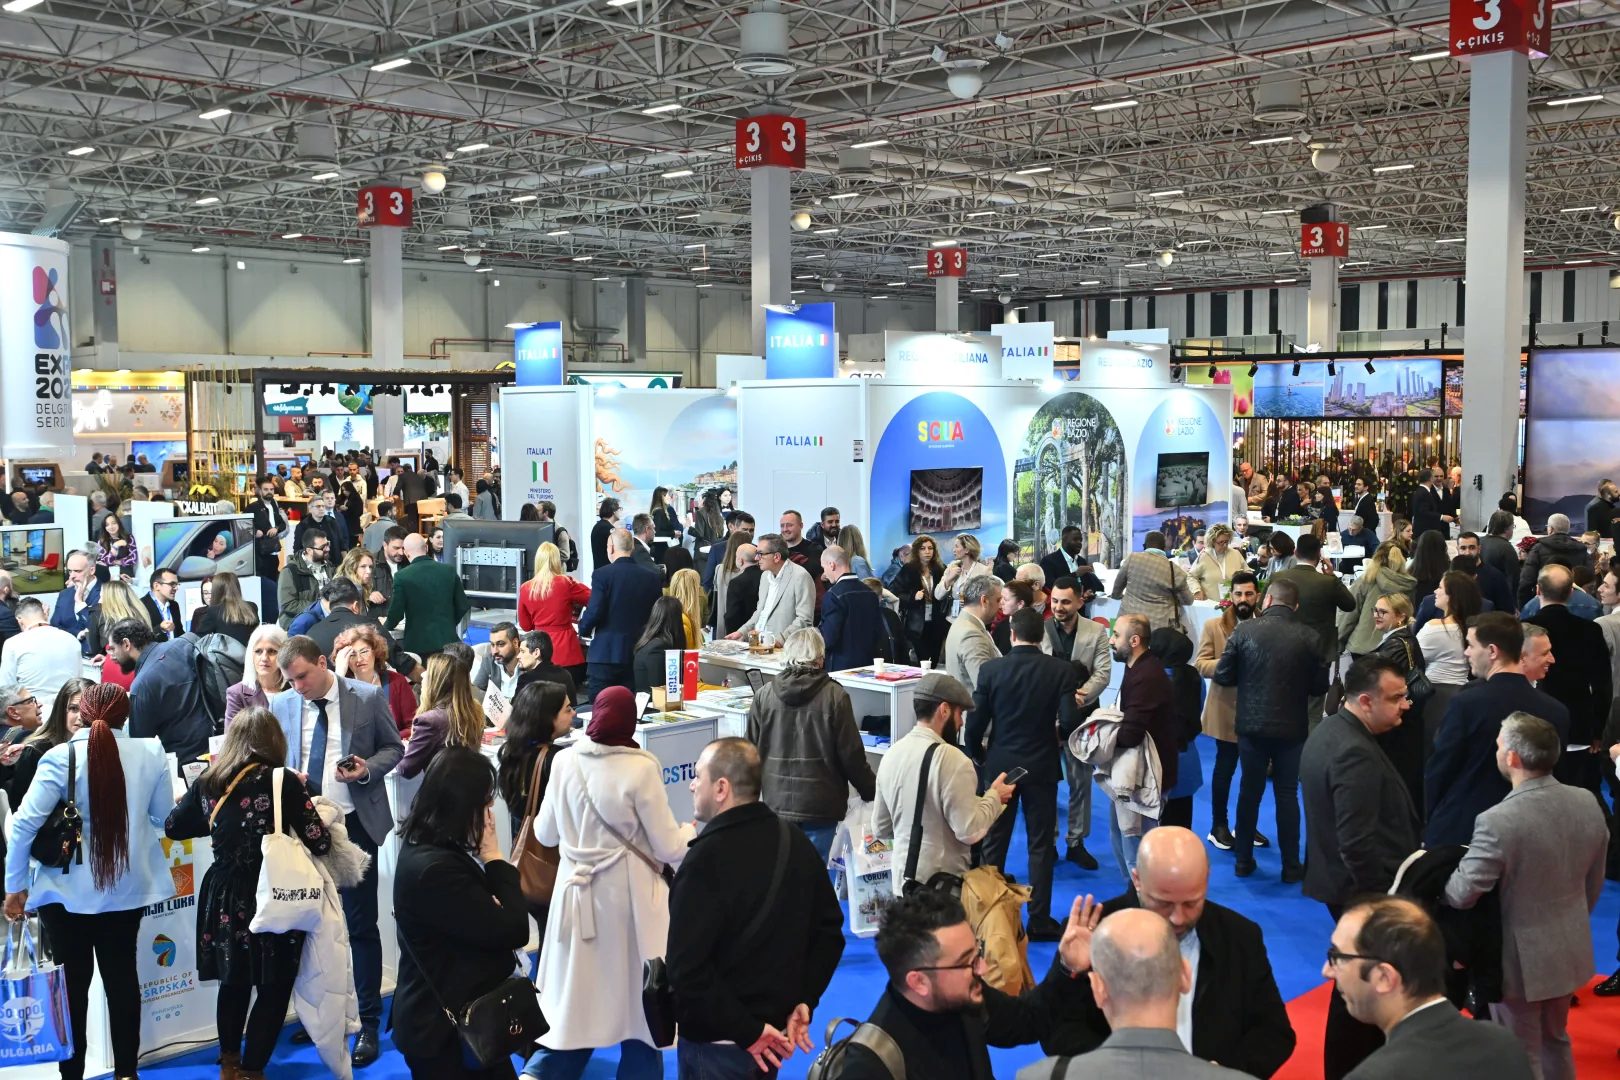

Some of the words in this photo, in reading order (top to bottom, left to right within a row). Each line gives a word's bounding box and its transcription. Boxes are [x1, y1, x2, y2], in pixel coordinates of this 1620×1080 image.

[1473, 0, 1502, 30] 3
[1468, 32, 1504, 48] ÇIKIŞ
[746, 121, 760, 152] 3
[781, 121, 796, 152] 3
[744, 154, 762, 164] ÇIKIŞ
[364, 191, 374, 215] 3
[389, 191, 404, 215] 3
[1310, 226, 1323, 247] 3
[1336, 226, 1344, 247] 3
[934, 251, 943, 269] 3
[954, 251, 962, 269] 3
[771, 335, 815, 349] ITALIA
[518, 348, 548, 361] ITALIA
[1001, 346, 1035, 358] TALIA
[1067, 417, 1096, 428] REGIONE
[775, 435, 812, 447] ITALIA
[1067, 428, 1088, 438] LAZIO
[526, 447, 553, 456] ITALIA.IT
[662, 761, 697, 785] CSTÜ
[144, 979, 188, 998] SRPSKA
[0, 1042, 55, 1058] ULGARIA
